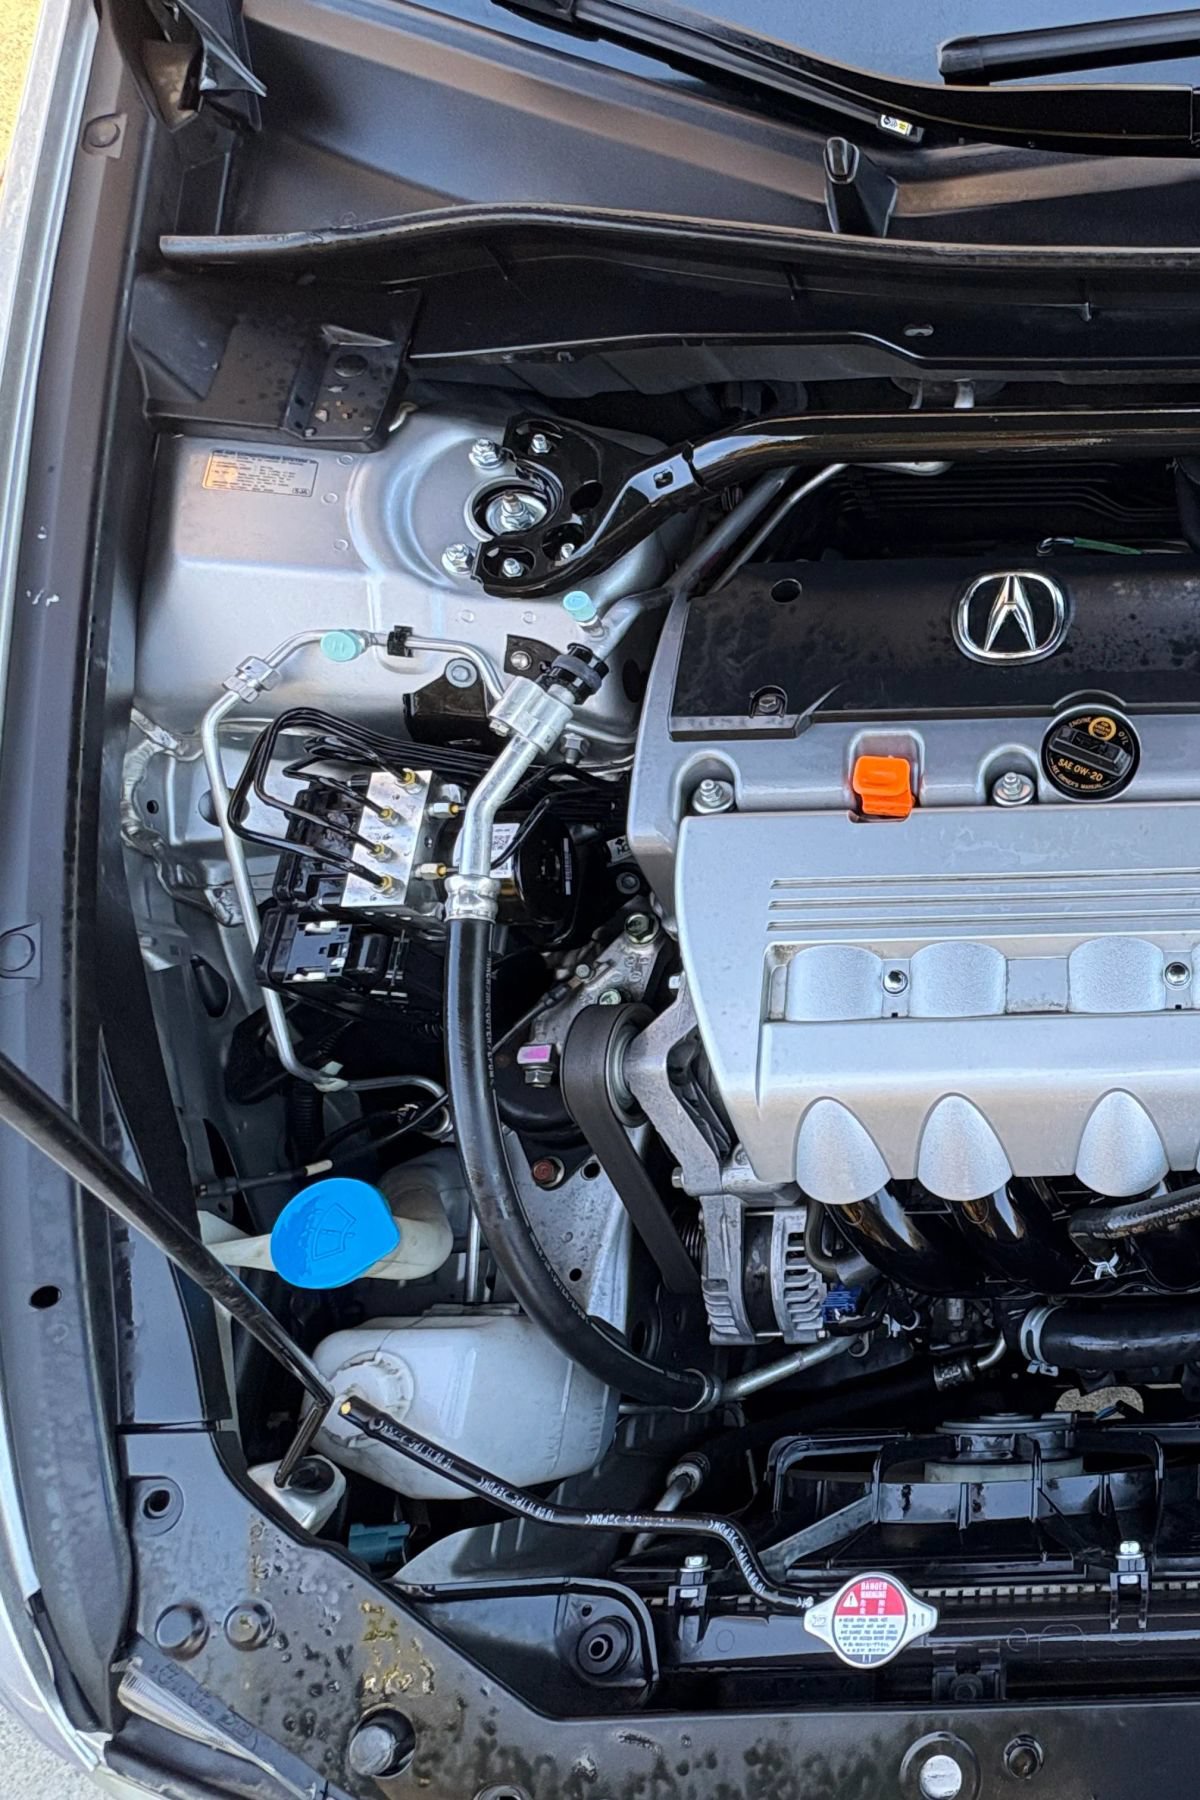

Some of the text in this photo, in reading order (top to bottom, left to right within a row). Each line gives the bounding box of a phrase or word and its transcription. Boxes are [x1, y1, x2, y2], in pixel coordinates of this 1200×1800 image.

[1068, 716, 1092, 728] ENGINE
[1118, 731, 1129, 745] OIL
[1058, 759, 1103, 782] SAE 0W-20
[861, 1582, 887, 1590] DANGER
